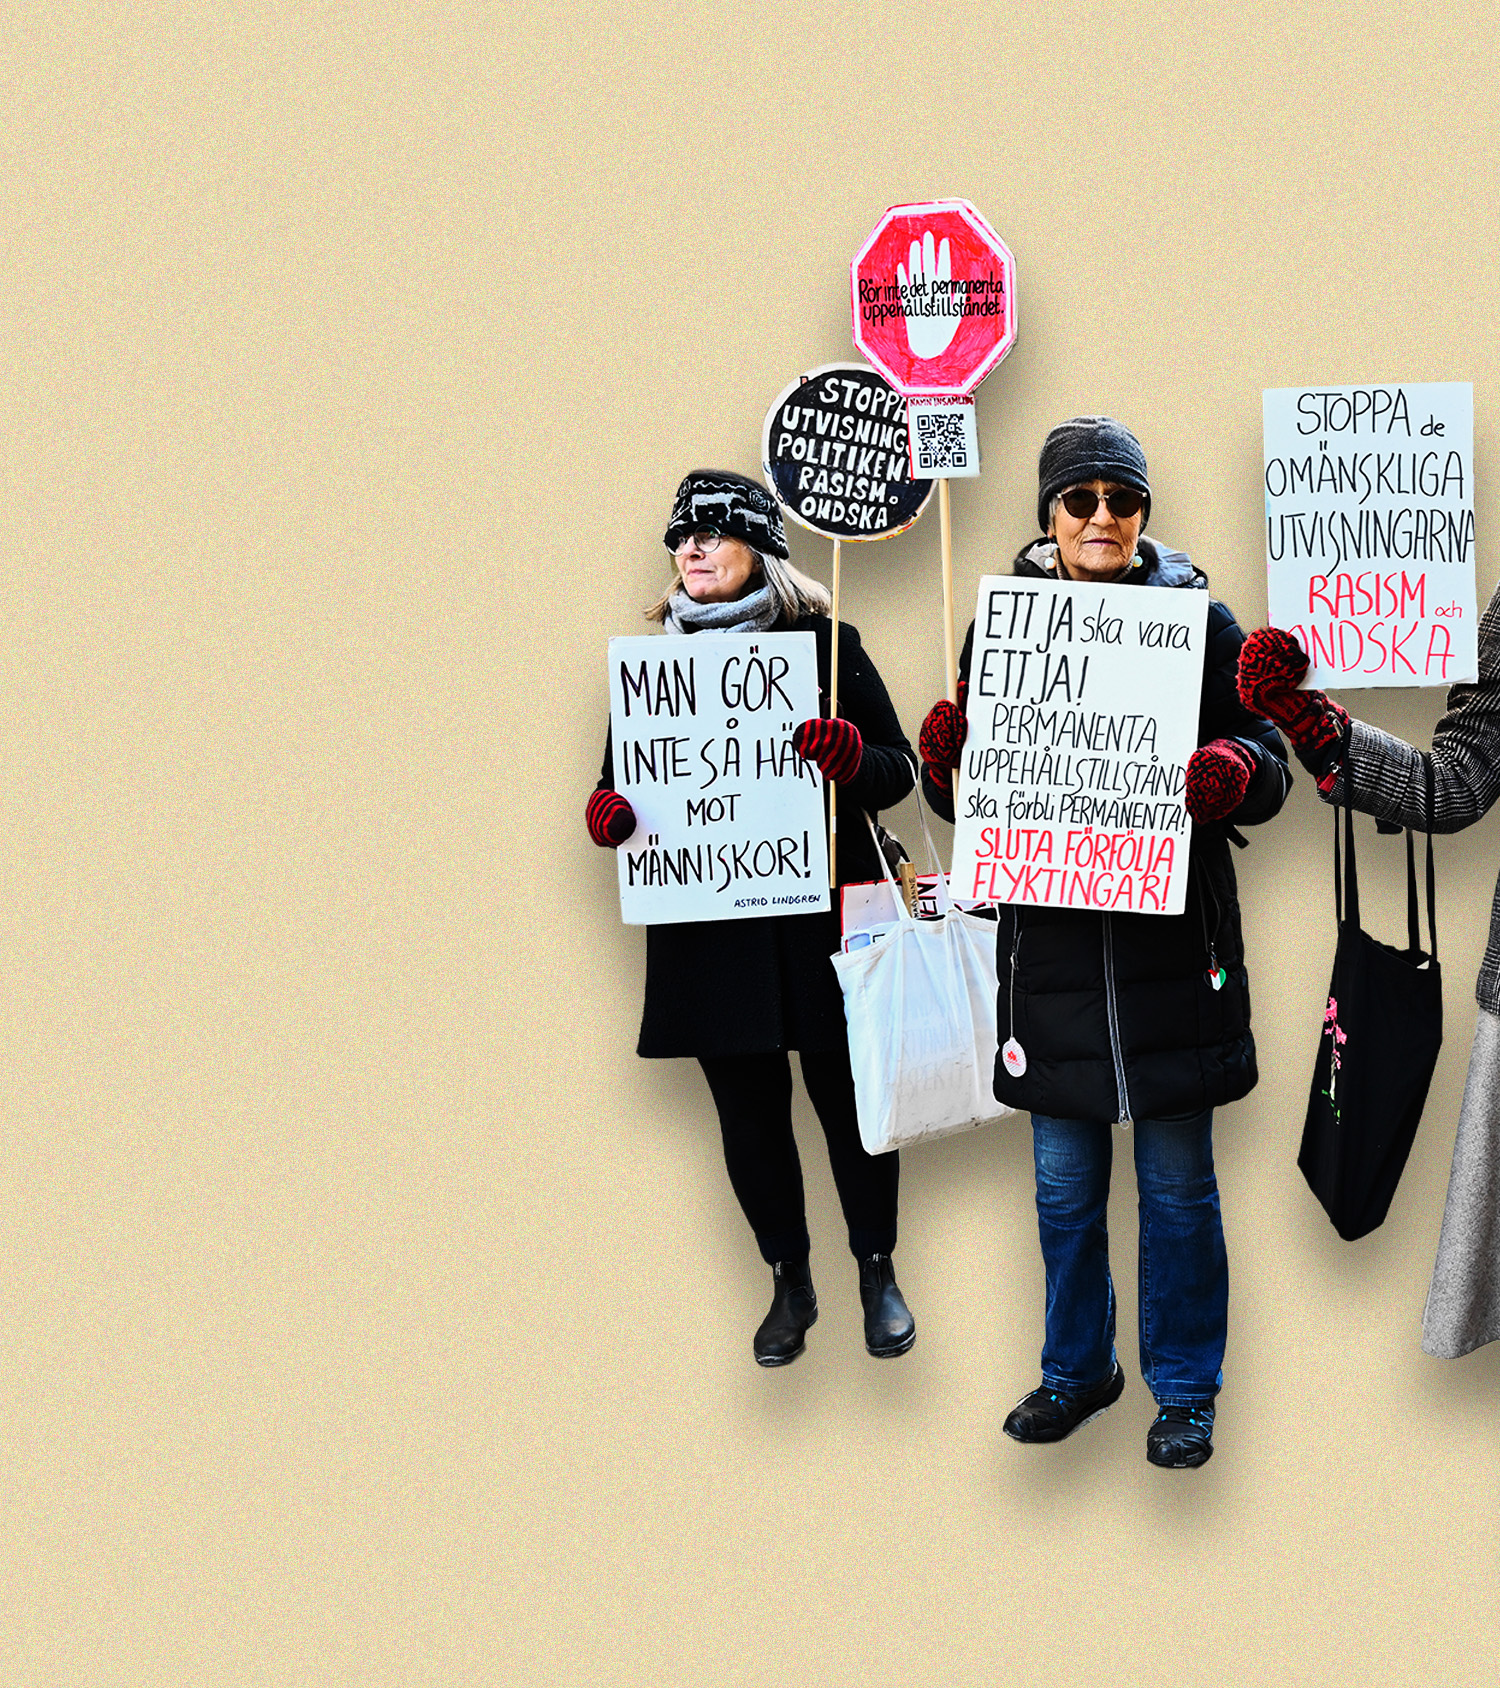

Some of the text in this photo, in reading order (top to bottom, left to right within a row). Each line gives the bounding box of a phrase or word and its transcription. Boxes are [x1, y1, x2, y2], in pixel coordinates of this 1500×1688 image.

[859, 272, 1004, 303] Rör inte det permanenta
[863, 297, 1004, 326] uppehållstillståndet.
[818, 377, 908, 424] STOPPA
[1297, 388, 1445, 437] STOPPA de
[798, 466, 888, 504] RASISM
[1266, 440, 1464, 505] OMÄNSKLIGA
[800, 496, 888, 530] ONDSKA
[1268, 508, 1475, 578] UTVISNINGARNA
[1309, 570, 1462, 618] RASISM och
[986, 591, 1191, 654] ETT JA ska vara
[620, 645, 793, 717] MAN GÖR
[979, 650, 1088, 706] ETT JA!
[992, 703, 1157, 754] PERMANENTA
[623, 737, 692, 785] INTE
[700, 718, 740, 790] SÅ
[969, 746, 1186, 800] UPPEHÅLLSTILLSTÅND
[687, 794, 742, 826] MOT
[964, 788, 1188, 835] ska förbli PERMANENTA!
[628, 830, 812, 892] MÄNNISKOR!
[974, 826, 1175, 876] SLUTA FÖRFÖLJA
[734, 894, 820, 908] ASTRID LINDGREN
[972, 862, 1171, 911] FLYKTINGAR!
